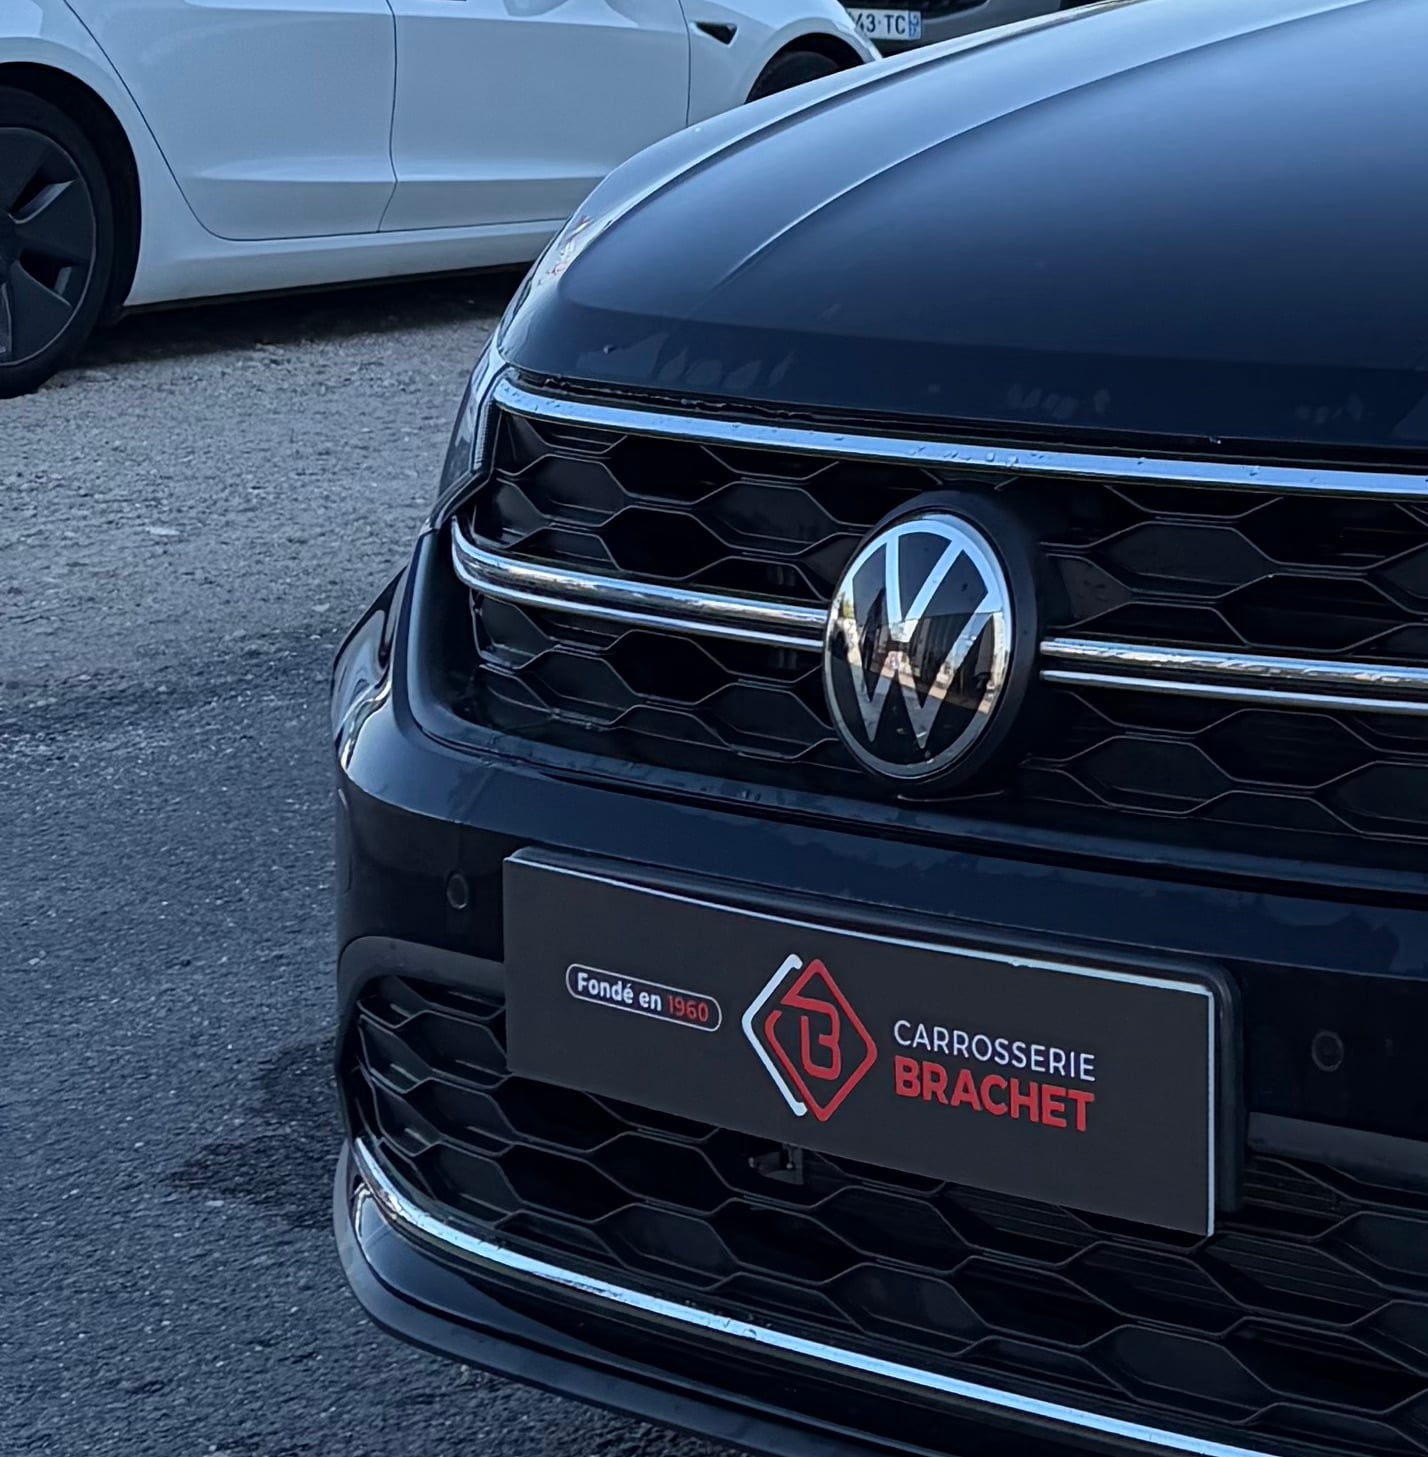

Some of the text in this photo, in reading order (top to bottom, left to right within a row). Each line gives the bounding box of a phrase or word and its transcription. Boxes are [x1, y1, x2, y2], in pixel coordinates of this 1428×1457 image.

[832, 522, 1007, 766] VW
[577, 972, 709, 1022] Fondé en 1960
[894, 1019, 1096, 1081] CARROSSERIE
[894, 1055, 1095, 1132] BRACHET
